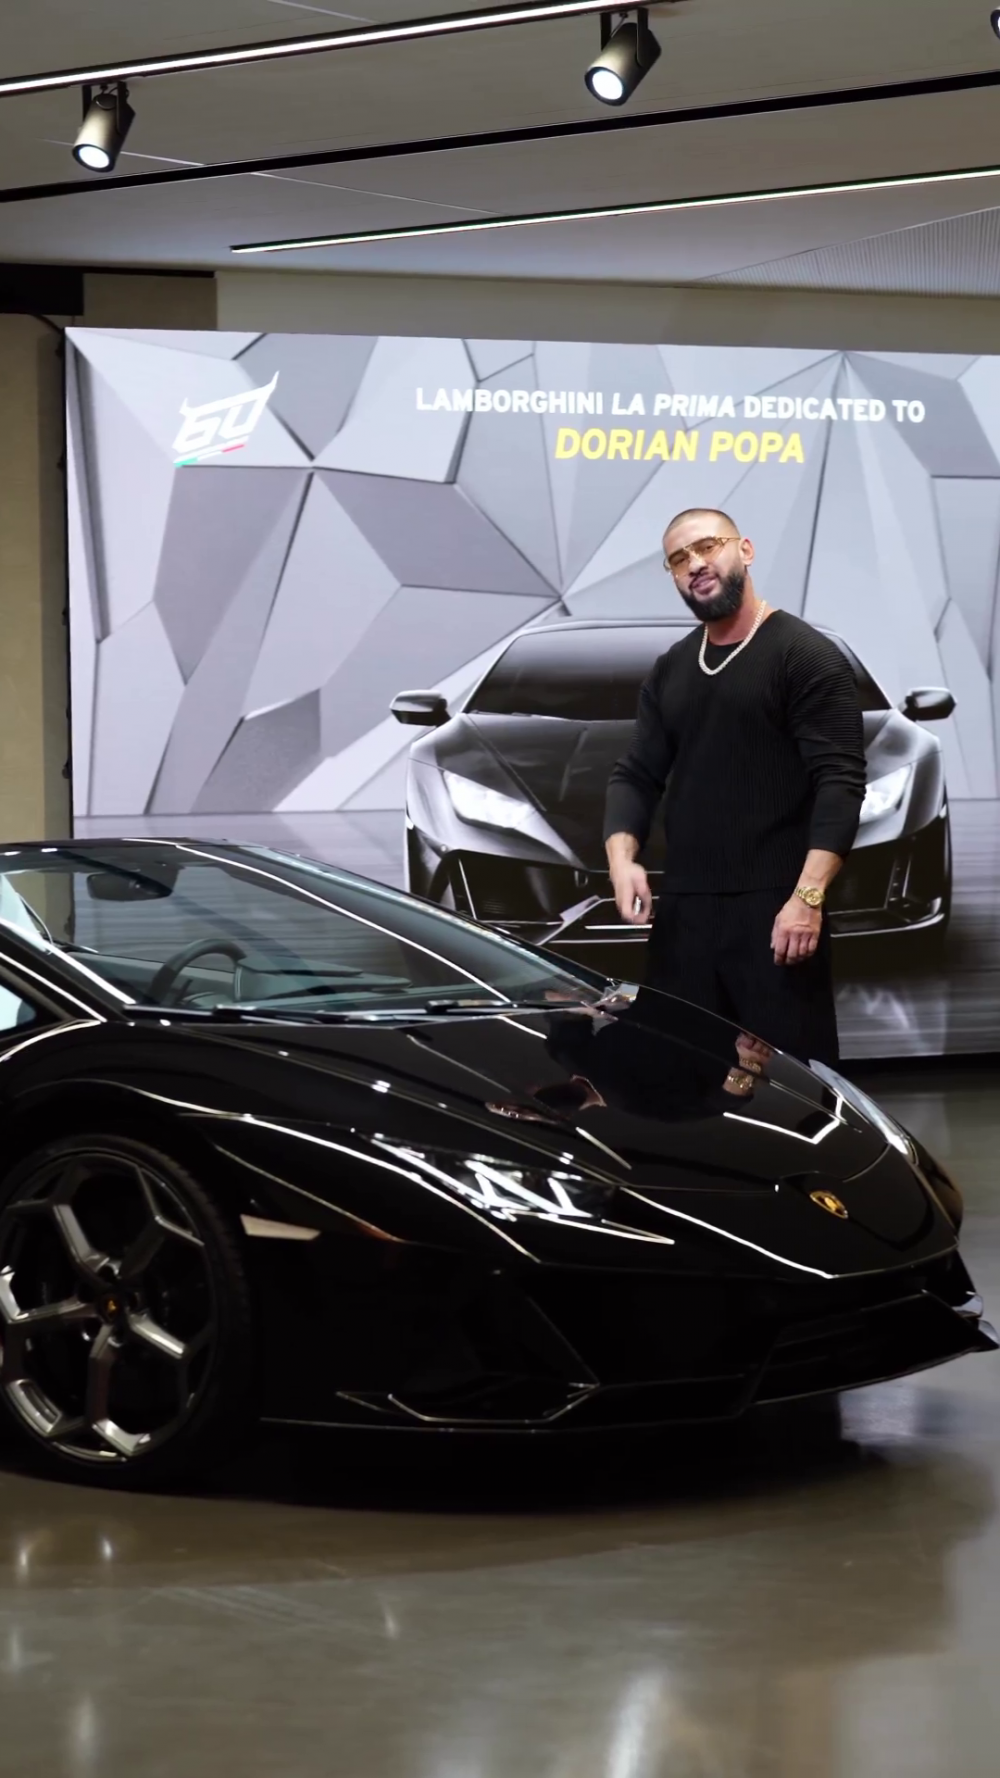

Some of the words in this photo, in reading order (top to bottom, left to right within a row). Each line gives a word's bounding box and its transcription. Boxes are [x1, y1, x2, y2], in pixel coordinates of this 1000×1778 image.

[416, 387, 603, 415] LAMBORGHINI
[611, 392, 646, 416] LA
[653, 393, 736, 418] PRIMA
[744, 395, 886, 422] DEDICATED
[891, 399, 926, 424] TO
[555, 427, 699, 462] DORIAN
[709, 431, 805, 464] POPA
